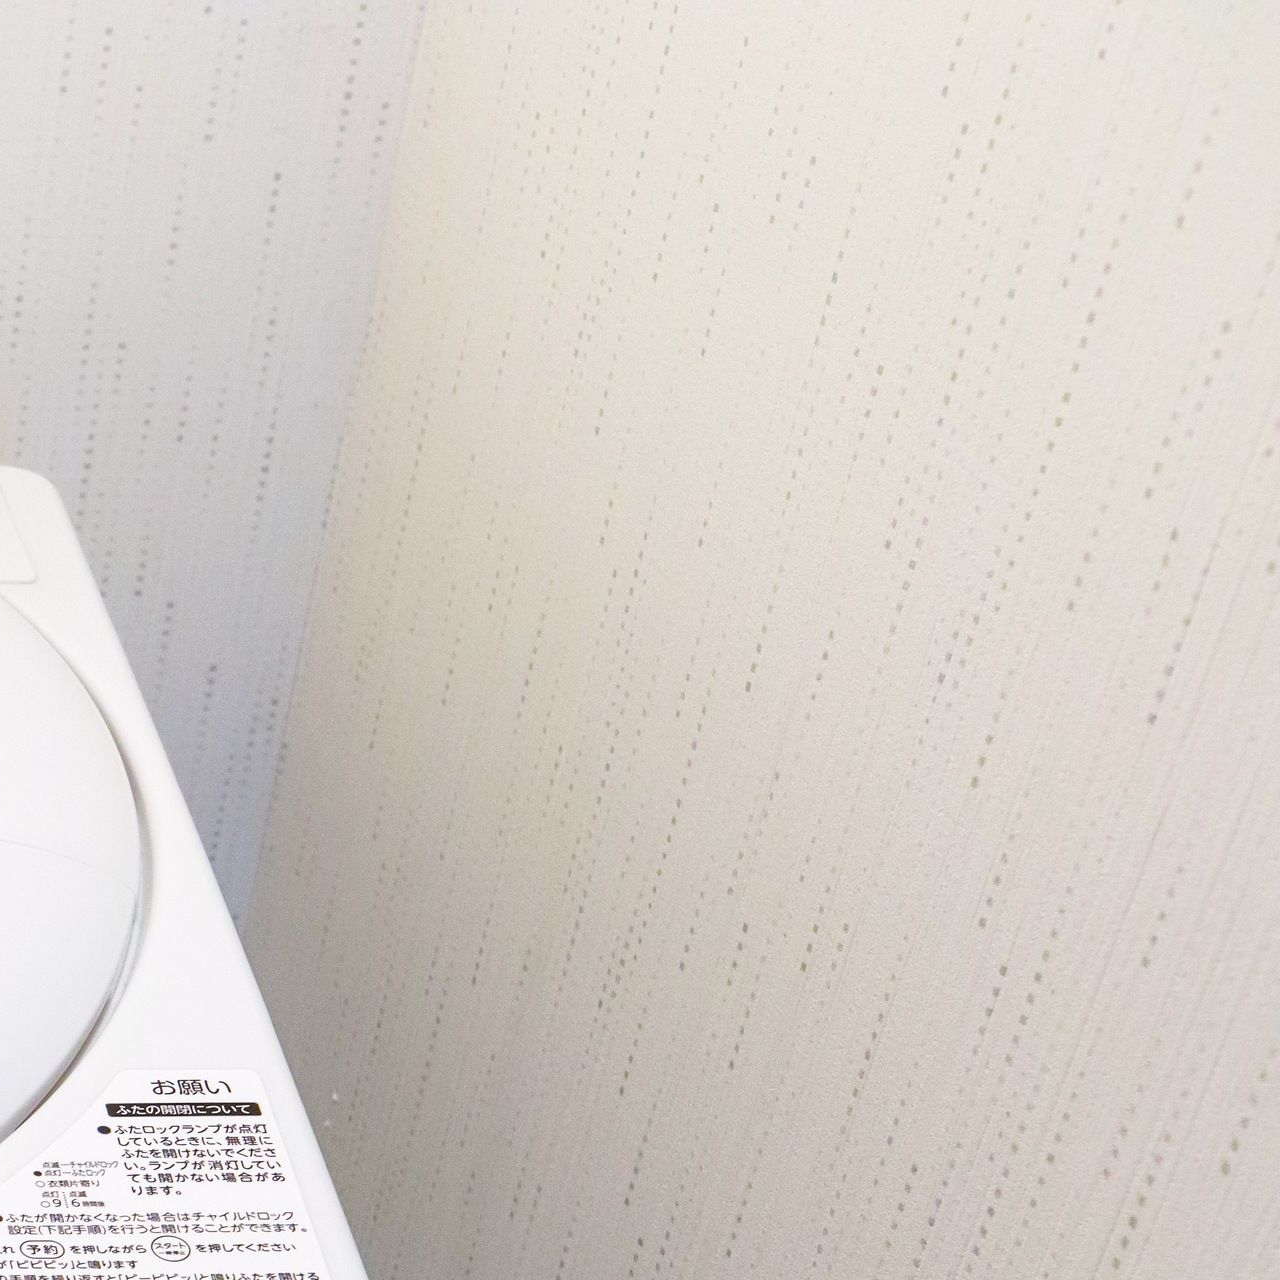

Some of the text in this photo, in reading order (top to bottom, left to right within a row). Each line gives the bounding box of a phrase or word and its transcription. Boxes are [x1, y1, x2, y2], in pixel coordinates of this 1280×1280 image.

[150, 1079, 232, 1096] お願い
[116, 1104, 251, 1116] ふたの開閉について
[115, 1123, 268, 1135] ふたロックランプが点灯
[117, 1136, 273, 1147] しているときに、無理に
[122, 1148, 277, 1159] ふたを開けないでくださ
[123, 1160, 282, 1171] い。ランプが消灯してい
[126, 1172, 286, 1183] ても開かない場合があ
[131, 1185, 183, 1196] ります。
[52, 1198, 62, 1207] 9
[5, 1211, 294, 1223] ふたが開かなくなった場合はチャイルドロック
[26, 1244, 59, 1255] 予約
[69, 1244, 147, 1255] を押しながら
[154, 1242, 187, 1250] スタート
[195, 1242, 297, 1253] を押してください
